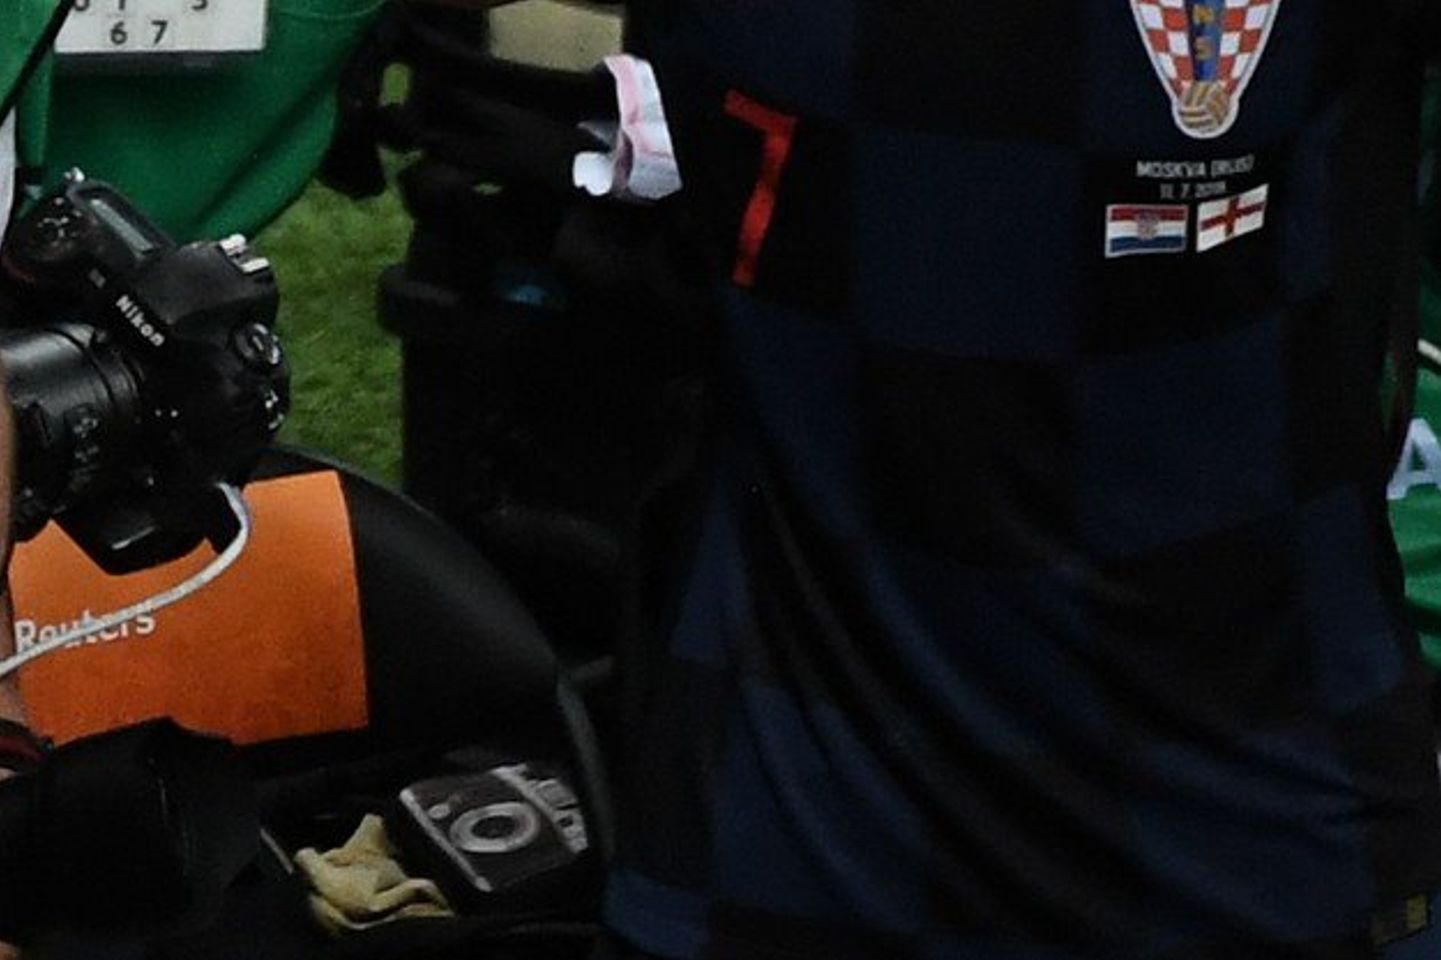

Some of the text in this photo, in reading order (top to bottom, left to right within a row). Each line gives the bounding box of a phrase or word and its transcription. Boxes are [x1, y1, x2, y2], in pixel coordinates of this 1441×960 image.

[111, 20, 169, 44] 6 7
[722, 88, 798, 287] 7
[115, 293, 167, 347] Nikon
